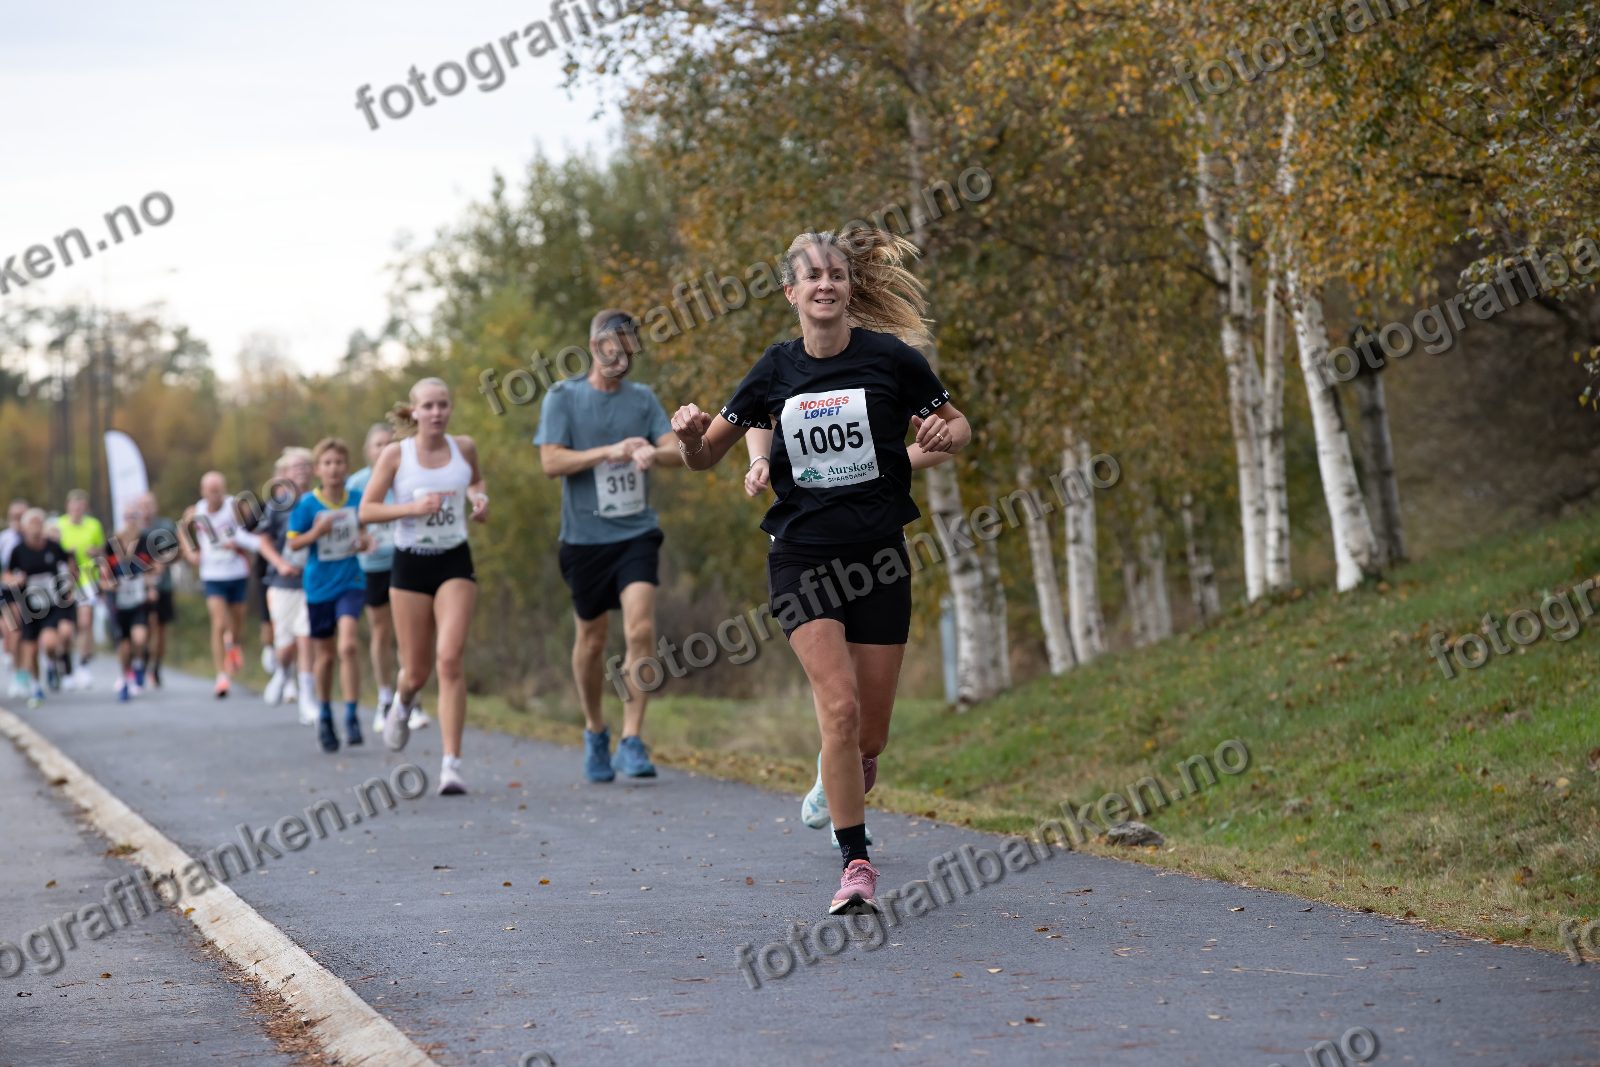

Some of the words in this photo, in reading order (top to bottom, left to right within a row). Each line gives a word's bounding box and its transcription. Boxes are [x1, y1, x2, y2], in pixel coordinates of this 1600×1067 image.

[799, 396, 850, 410] NORGES
[804, 406, 842, 420] LØPET
[793, 421, 864, 456] 1005
[827, 461, 875, 476] Aurskog
[606, 472, 636, 495] 319
[426, 506, 455, 527] 206
